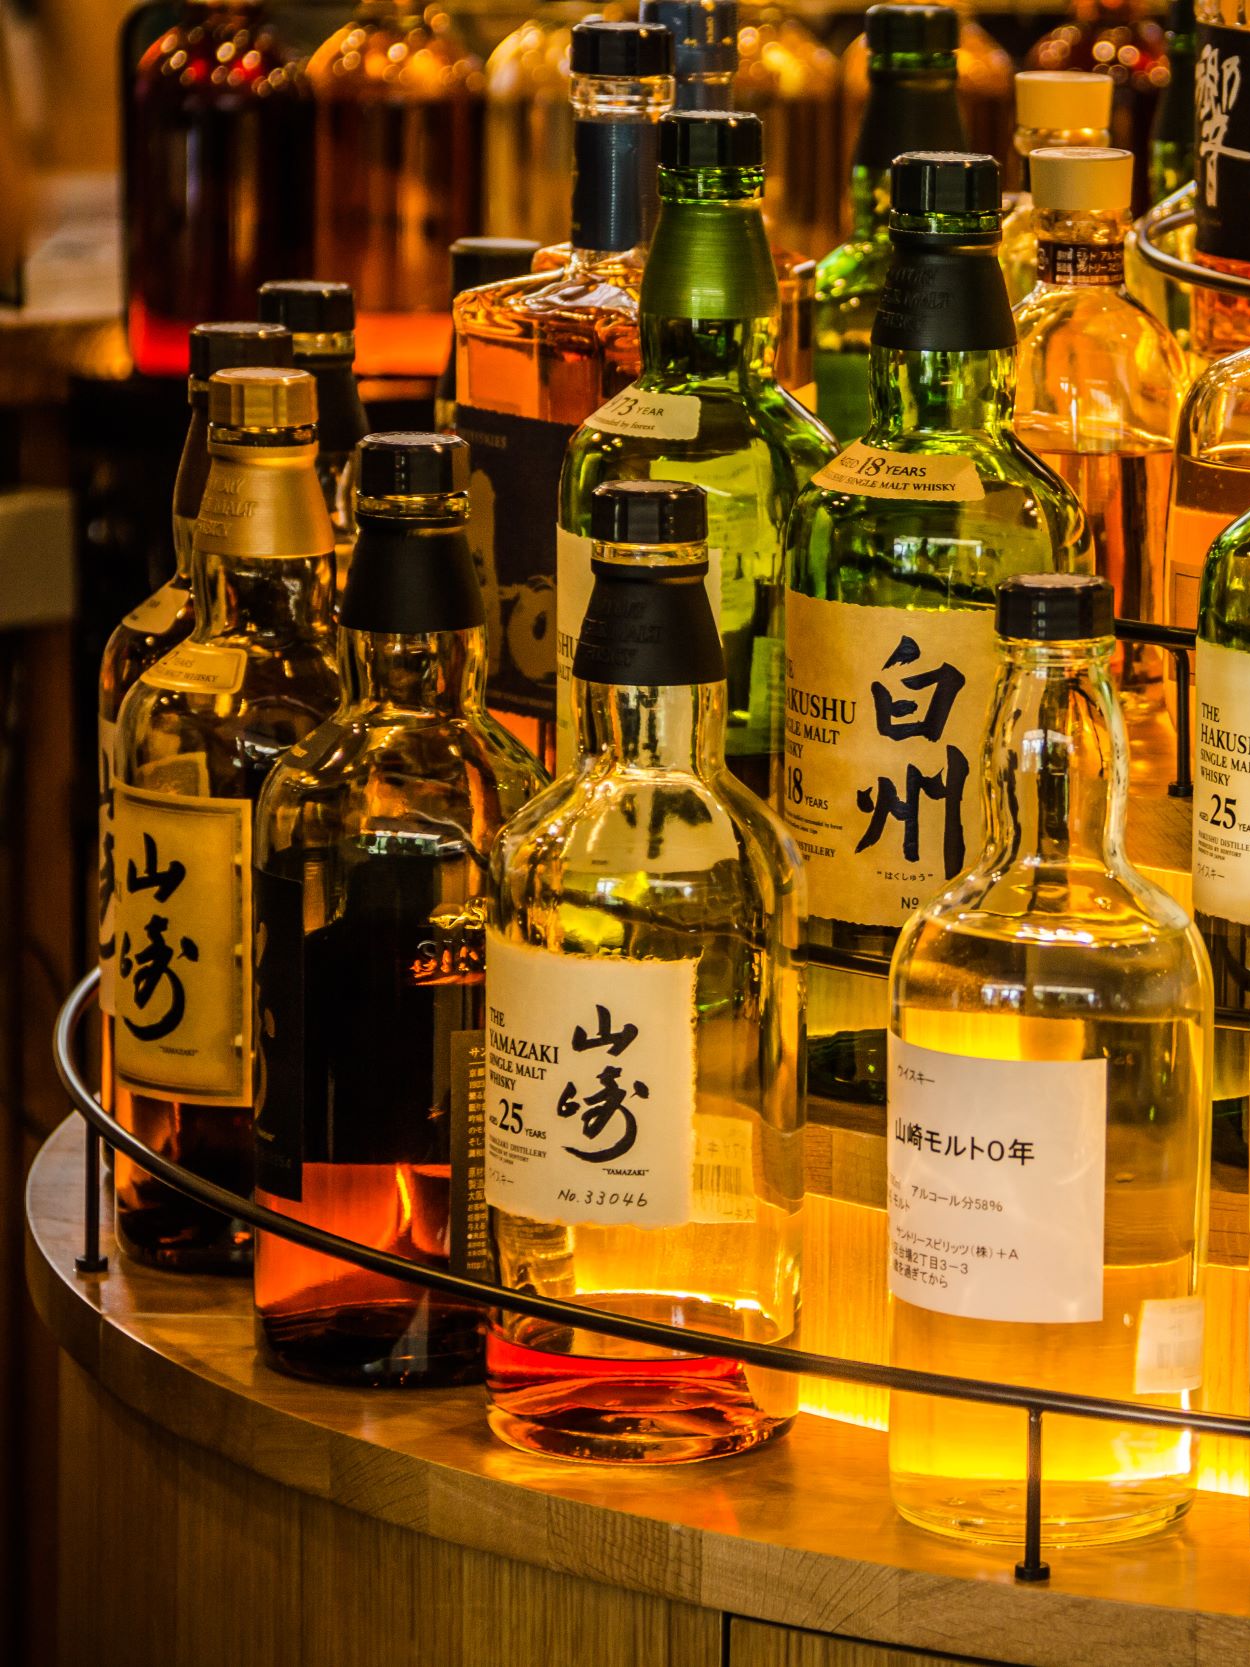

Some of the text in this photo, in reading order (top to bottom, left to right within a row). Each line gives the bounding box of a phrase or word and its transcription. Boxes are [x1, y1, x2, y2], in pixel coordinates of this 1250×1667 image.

[637, 406, 664, 417] YEAR
[856, 456, 886, 477] 18
[885, 465, 927, 477] YEARS
[847, 476, 878, 488] SINGLE
[879, 481, 910, 491] MALT
[912, 483, 957, 492] WHISKY
[785, 687, 857, 725] AKUSHU
[1201, 702, 1220, 723] THE
[803, 728, 841, 746] MALT
[855, 634, 970, 881] 白州
[1200, 749, 1228, 769] SINGLE
[1200, 765, 1231, 787] WHISKY
[787, 766, 829, 810] 18 YEARS
[1209, 793, 1237, 830] 25
[119, 832, 199, 1043] 山崎
[489, 1006, 505, 1028] THE
[489, 1028, 560, 1064] YAMAZAKI
[489, 1053, 547, 1080] SINGLE MALT
[897, 1064, 935, 1085] ウイスキー
[489, 1069, 517, 1091] WHISKY
[556, 1003, 650, 1164] 山崎
[498, 1098, 524, 1135] 25
[524, 1128, 547, 1140] YEARS
[510, 1143, 547, 1158] DISTILLERY
[911, 1185, 1004, 1212] アルコール分58%
